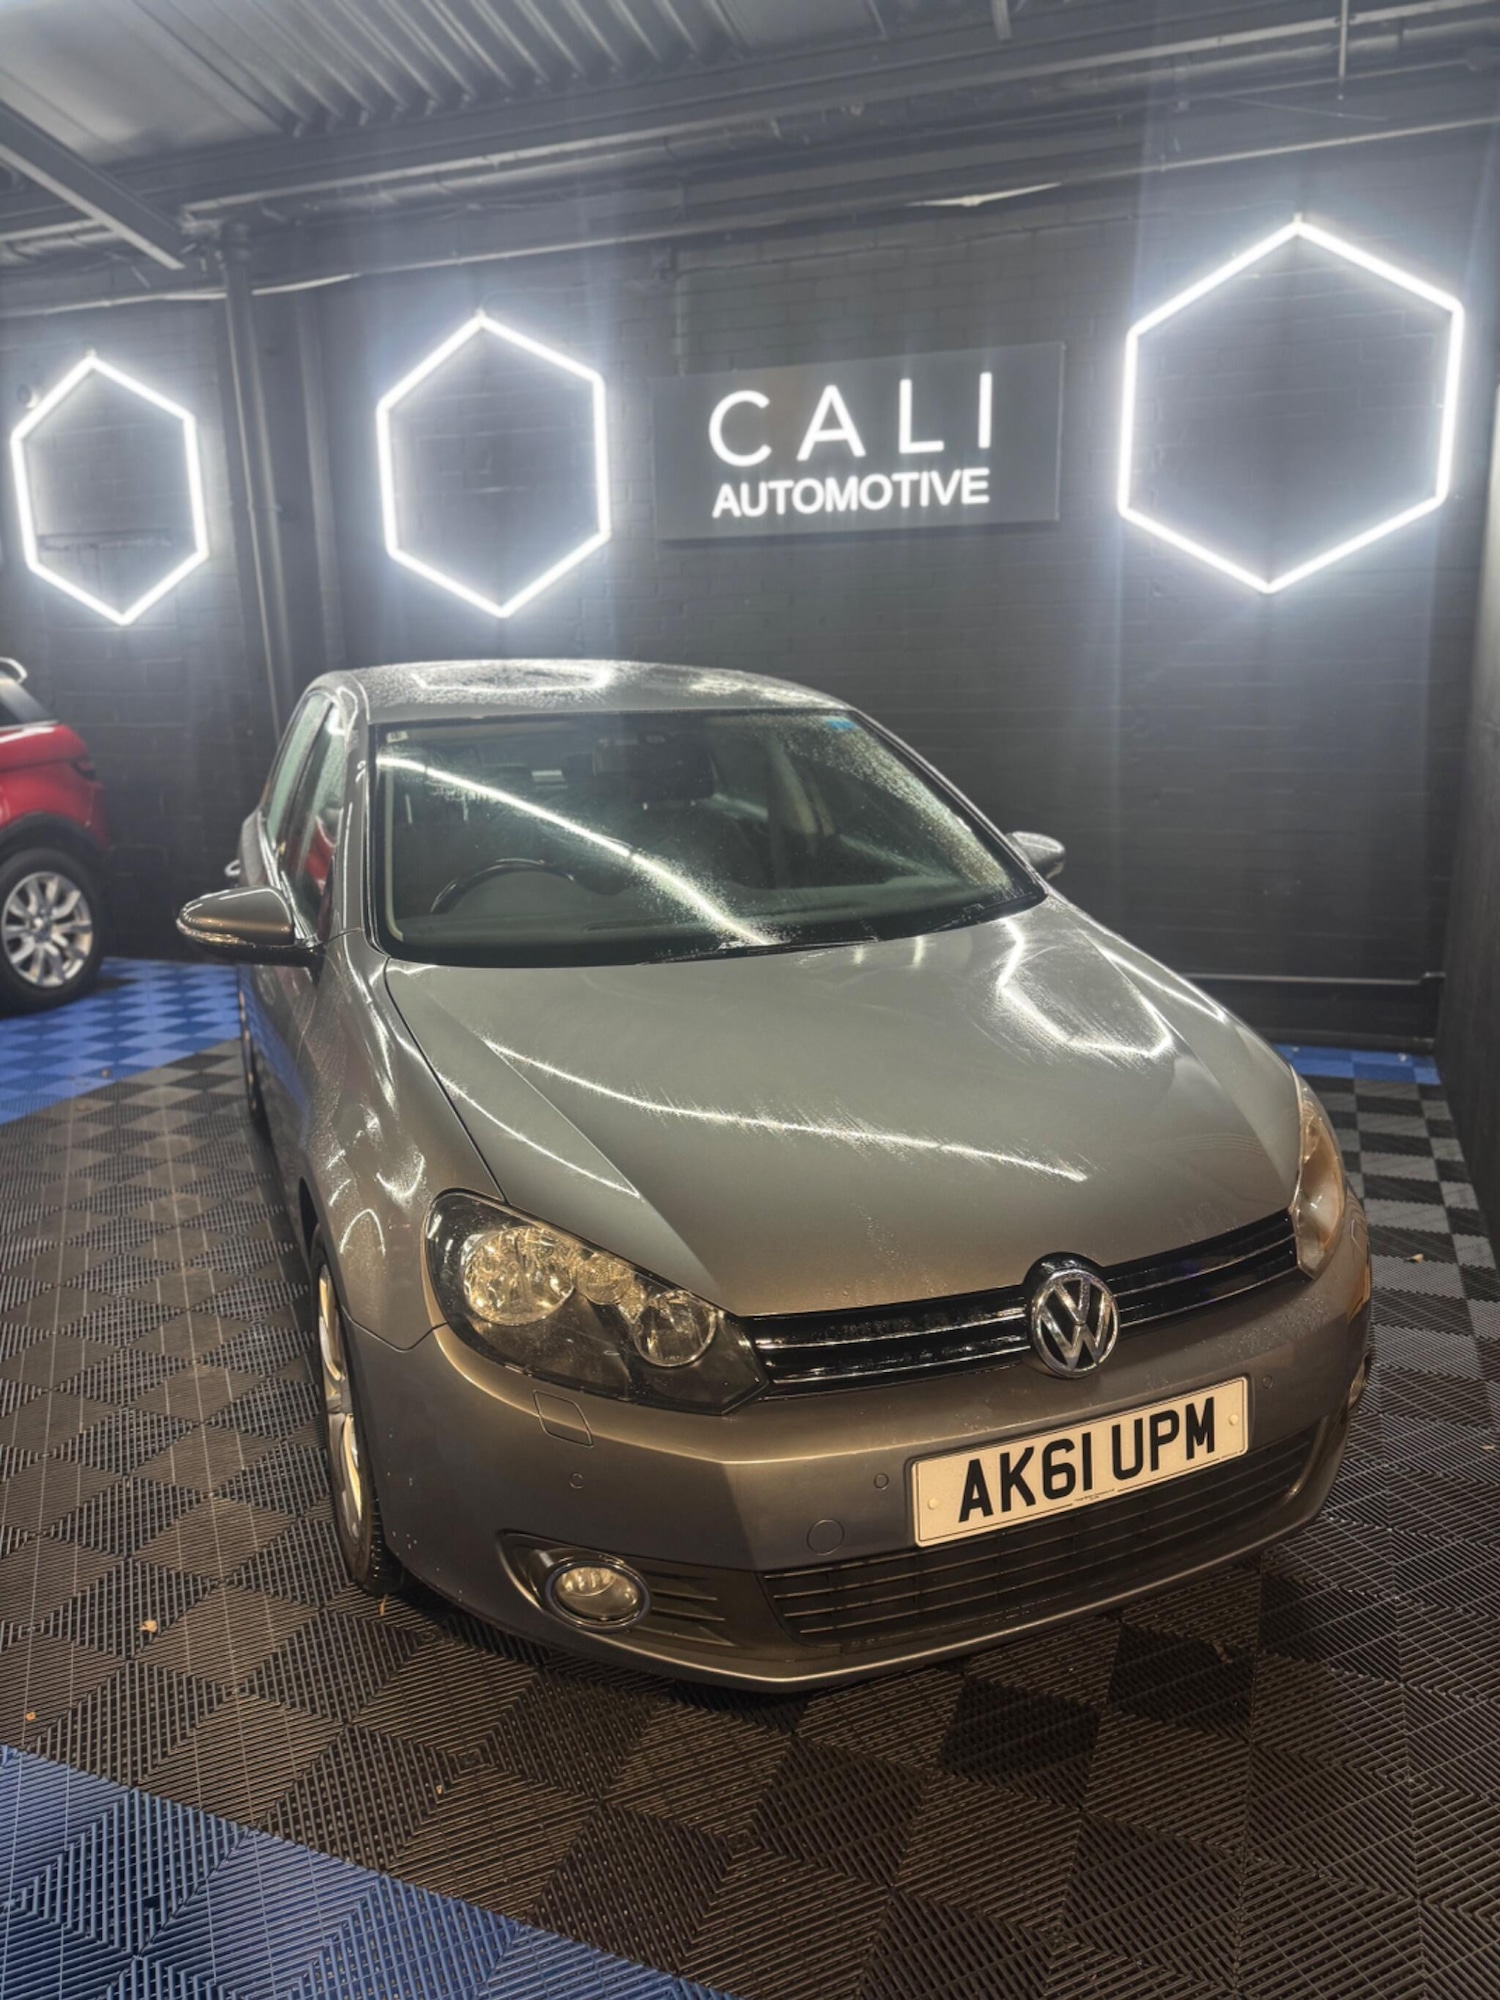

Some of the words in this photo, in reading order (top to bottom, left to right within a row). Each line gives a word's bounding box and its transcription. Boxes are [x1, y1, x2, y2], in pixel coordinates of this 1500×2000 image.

[708, 371, 993, 467] CALI
[711, 467, 990, 519] AUTOMOTIVE
[958, 1431, 1093, 1523] AK61
[1111, 1396, 1215, 1481] UPM
